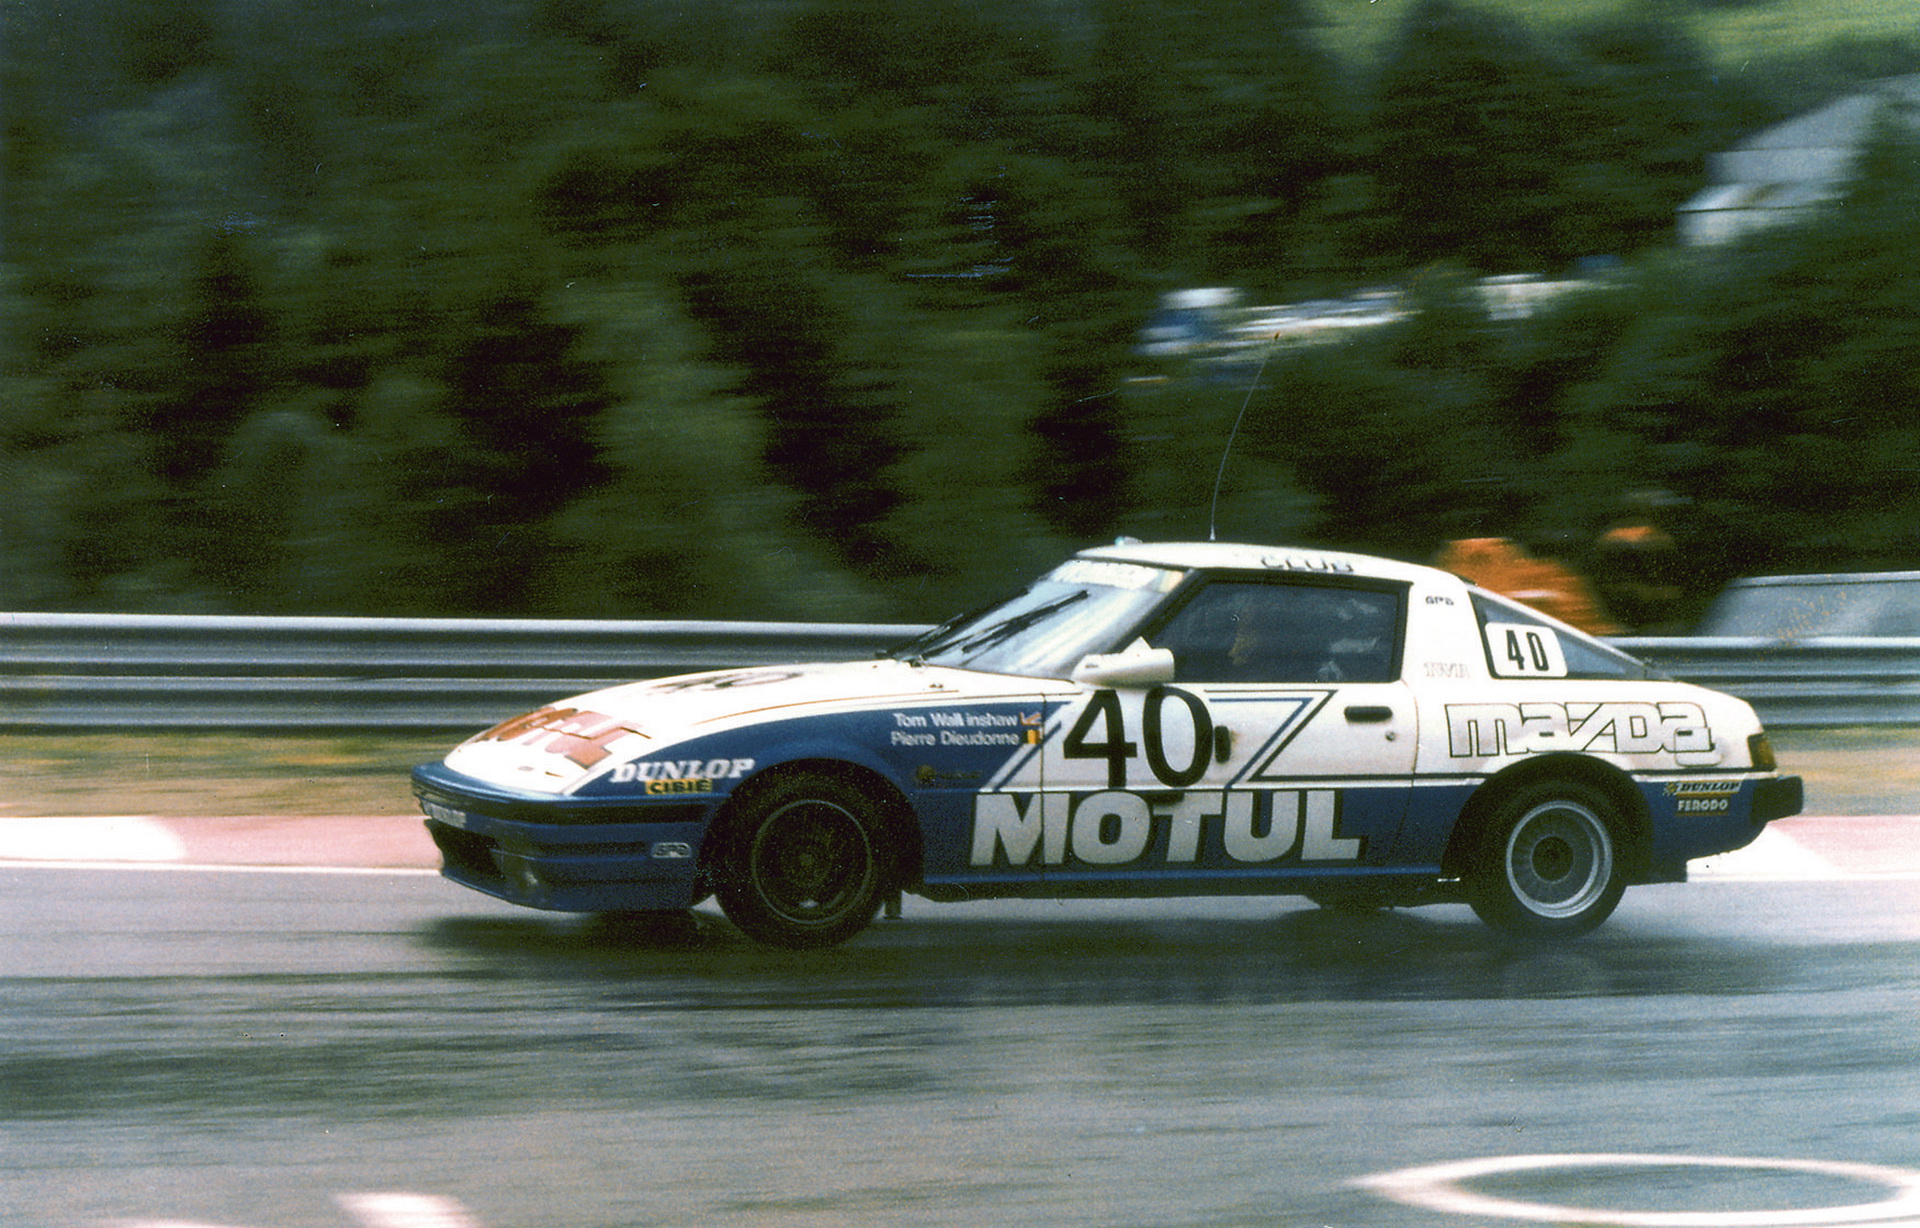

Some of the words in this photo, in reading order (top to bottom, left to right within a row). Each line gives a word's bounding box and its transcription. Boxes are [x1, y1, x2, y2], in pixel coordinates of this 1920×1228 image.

[1505, 629, 1550, 672] 40
[892, 712, 928, 728] Tom
[890, 730, 937, 747] Pierre
[940, 729, 1020, 746] Dieudonne
[1062, 684, 1214, 789] 40
[608, 757, 756, 783] DUNLOP
[1680, 782, 1740, 792] DUNLOP
[1677, 799, 1729, 812] FERODO
[969, 789, 1361, 867] MOTUL
